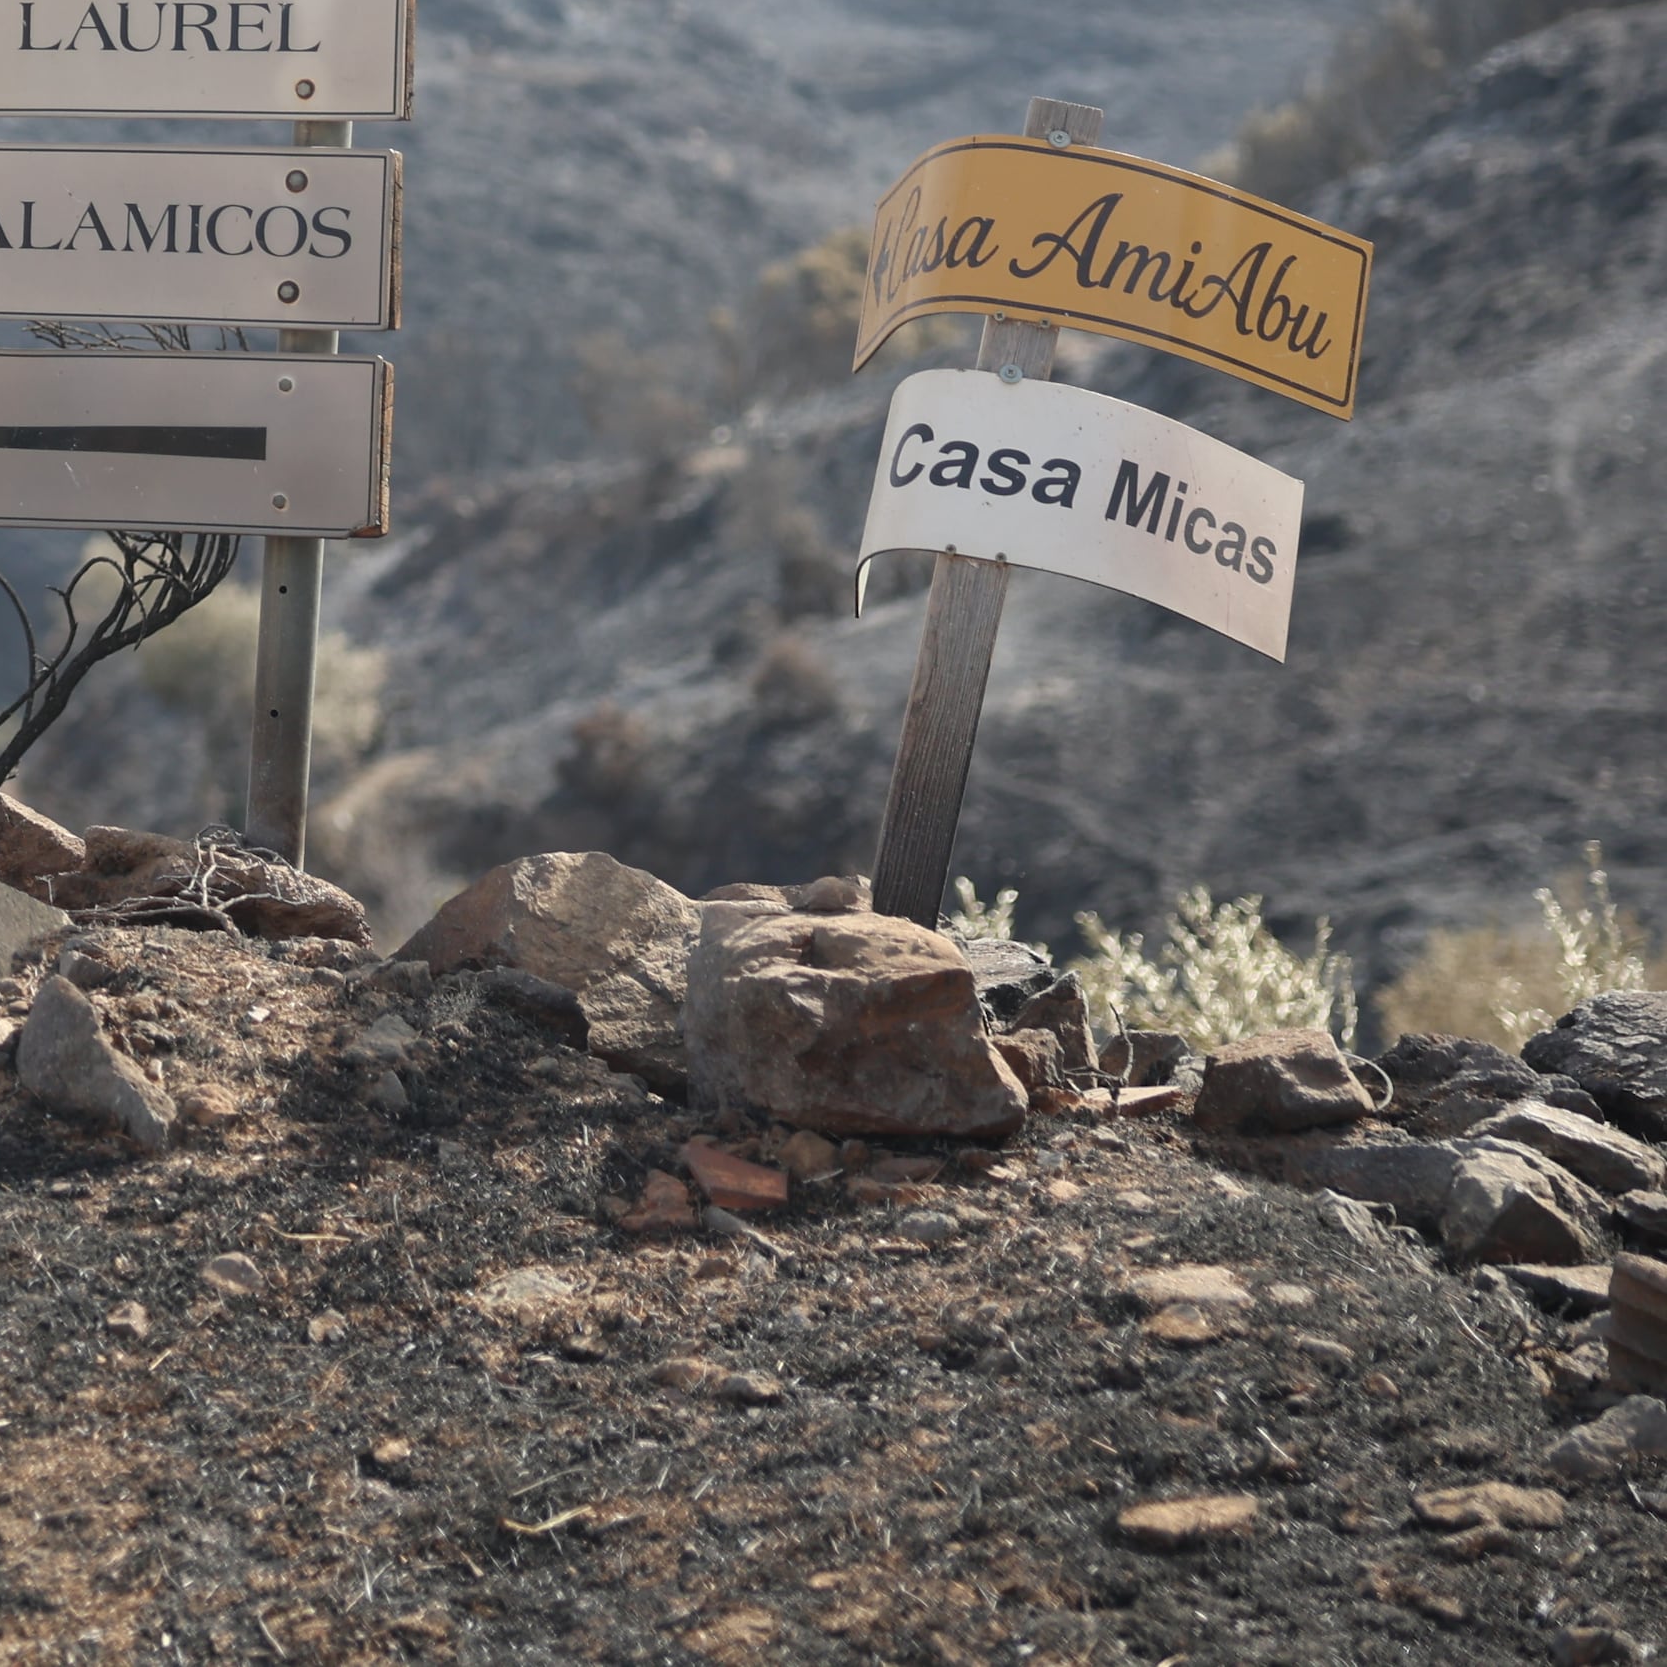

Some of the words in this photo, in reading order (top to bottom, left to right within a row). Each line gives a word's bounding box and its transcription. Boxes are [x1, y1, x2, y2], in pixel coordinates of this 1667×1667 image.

[18, 1, 322, 54] LAUREL
[887, 185, 1001, 304] Casa
[1008, 192, 1332, 360] AmiAbu
[889, 422, 1083, 510] Casa
[1103, 459, 1279, 585] Micas
